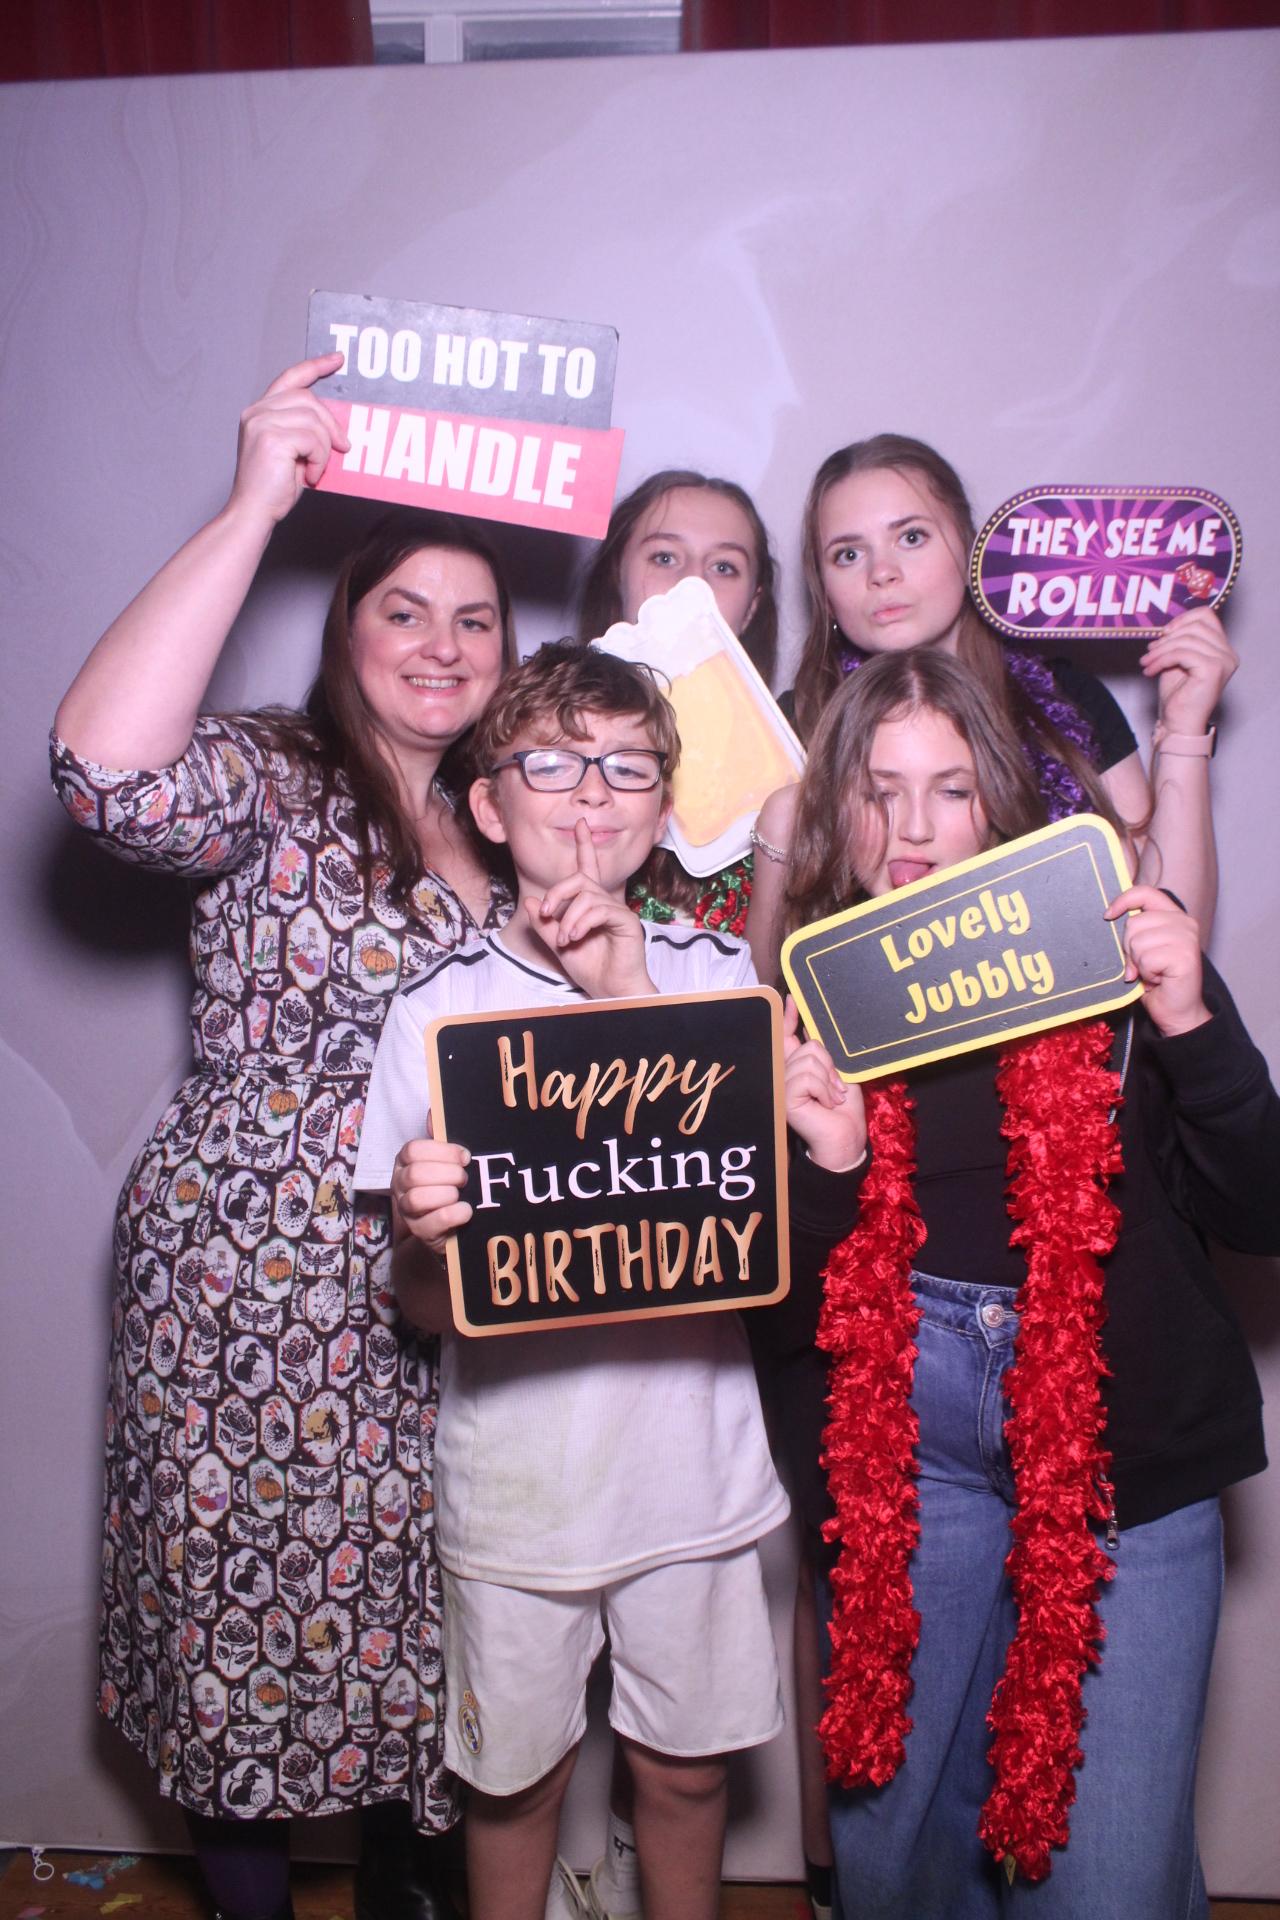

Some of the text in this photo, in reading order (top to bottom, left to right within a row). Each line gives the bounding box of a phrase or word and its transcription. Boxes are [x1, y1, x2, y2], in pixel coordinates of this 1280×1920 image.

[329, 323, 597, 400] TOO HOT TO
[342, 404, 583, 510] HANDLE
[1007, 517, 1222, 559] THEY SEE ME
[1006, 571, 1176, 617] ROLLIN
[879, 889, 1031, 973] Lovely
[904, 948, 1055, 1025] Jubbly
[497, 1030, 736, 1140] Happy
[471, 1137, 757, 1210] Fucking
[486, 1211, 763, 1307] BIRTHDAY
